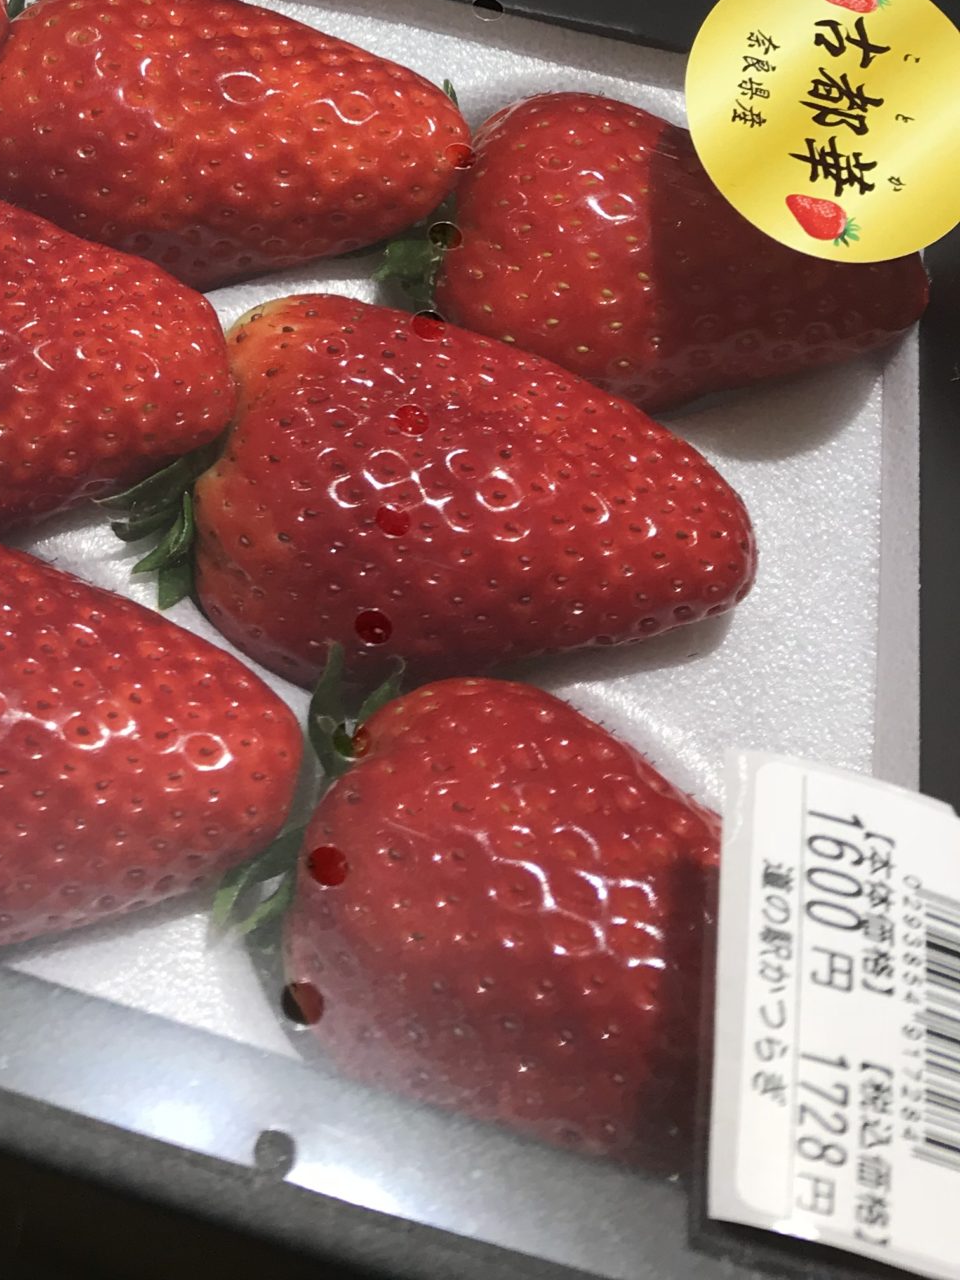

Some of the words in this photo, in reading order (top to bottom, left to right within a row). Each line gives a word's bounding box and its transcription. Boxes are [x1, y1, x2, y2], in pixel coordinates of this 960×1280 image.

[731, 29, 781, 129] 奈良県産
[788, 16, 892, 198] 古都華
[750, 858, 798, 1109] 道の駅かつらぎ
